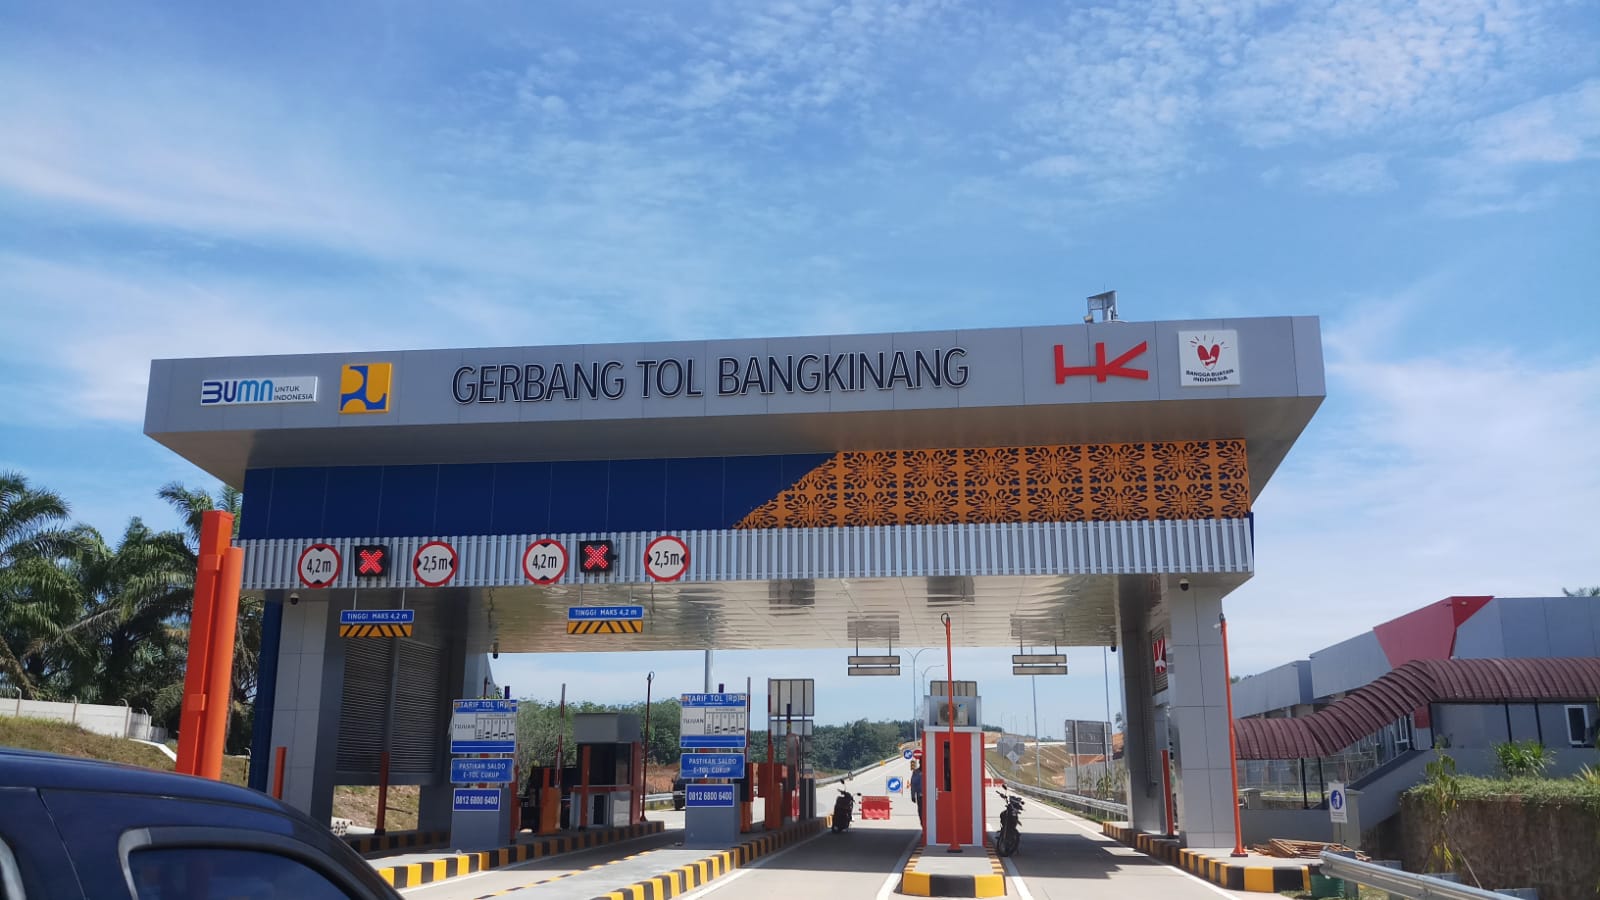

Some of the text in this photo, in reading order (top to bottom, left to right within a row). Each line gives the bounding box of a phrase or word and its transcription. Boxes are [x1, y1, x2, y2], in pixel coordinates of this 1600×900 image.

[452, 347, 969, 404] GERBANG TOL BANGKINANG
[275, 385, 300, 393] UNTUK
[274, 393, 313, 401] INDONESIA
[689, 792, 702, 801] 0812
[718, 792, 732, 801] 6400
